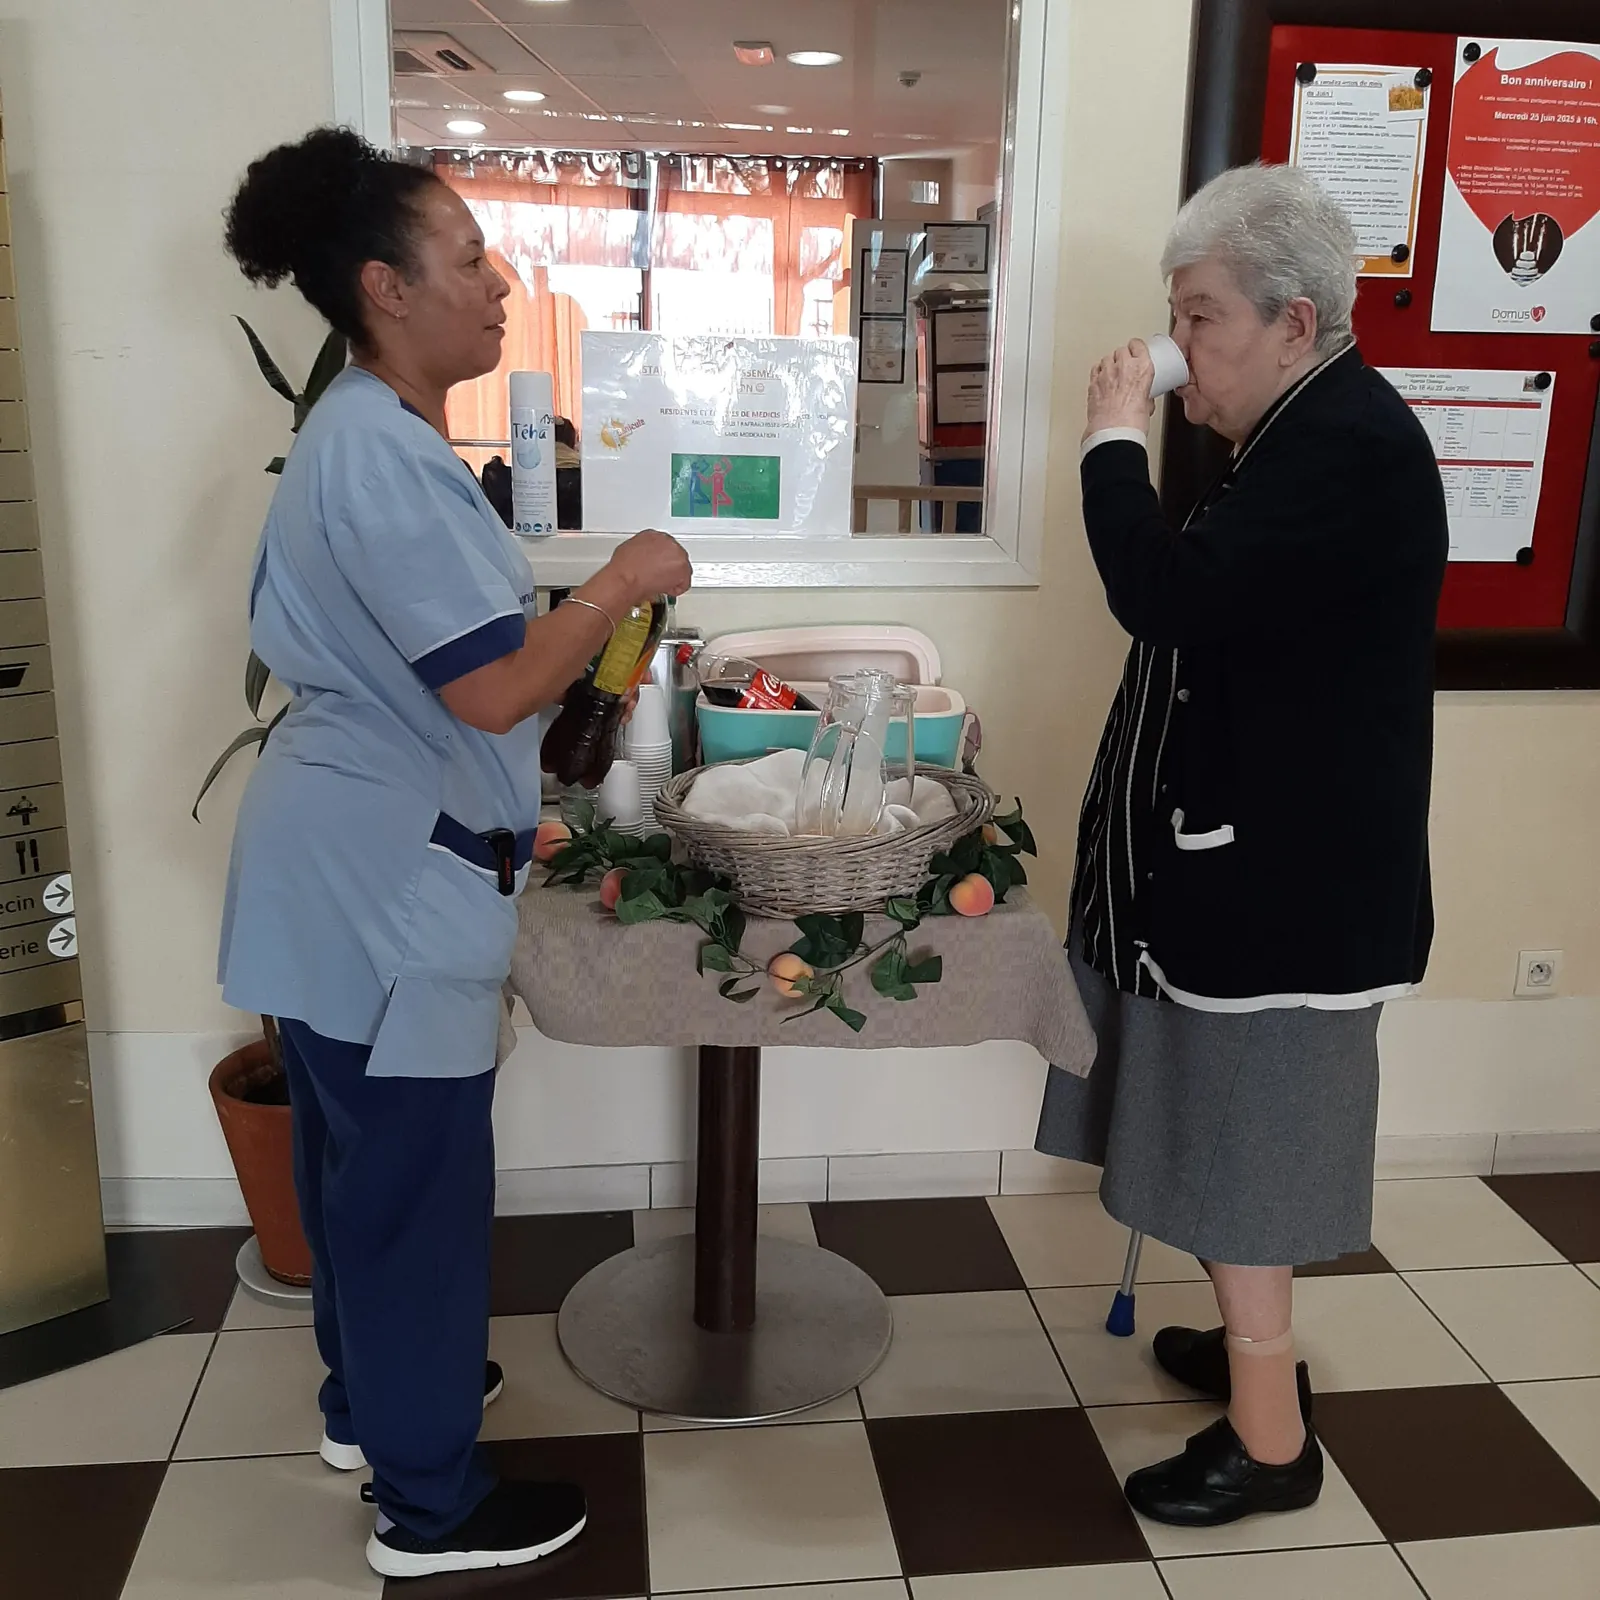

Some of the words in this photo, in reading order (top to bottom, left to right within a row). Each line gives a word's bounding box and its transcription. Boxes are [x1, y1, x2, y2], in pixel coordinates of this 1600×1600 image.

[1500, 74, 1522, 85] Bon
[1525, 77, 1587, 89] anniversaire
[1589, 79, 1593, 89] !
[1494, 111, 1529, 121] Mercredi
[1556, 114, 1575, 123] 2025
